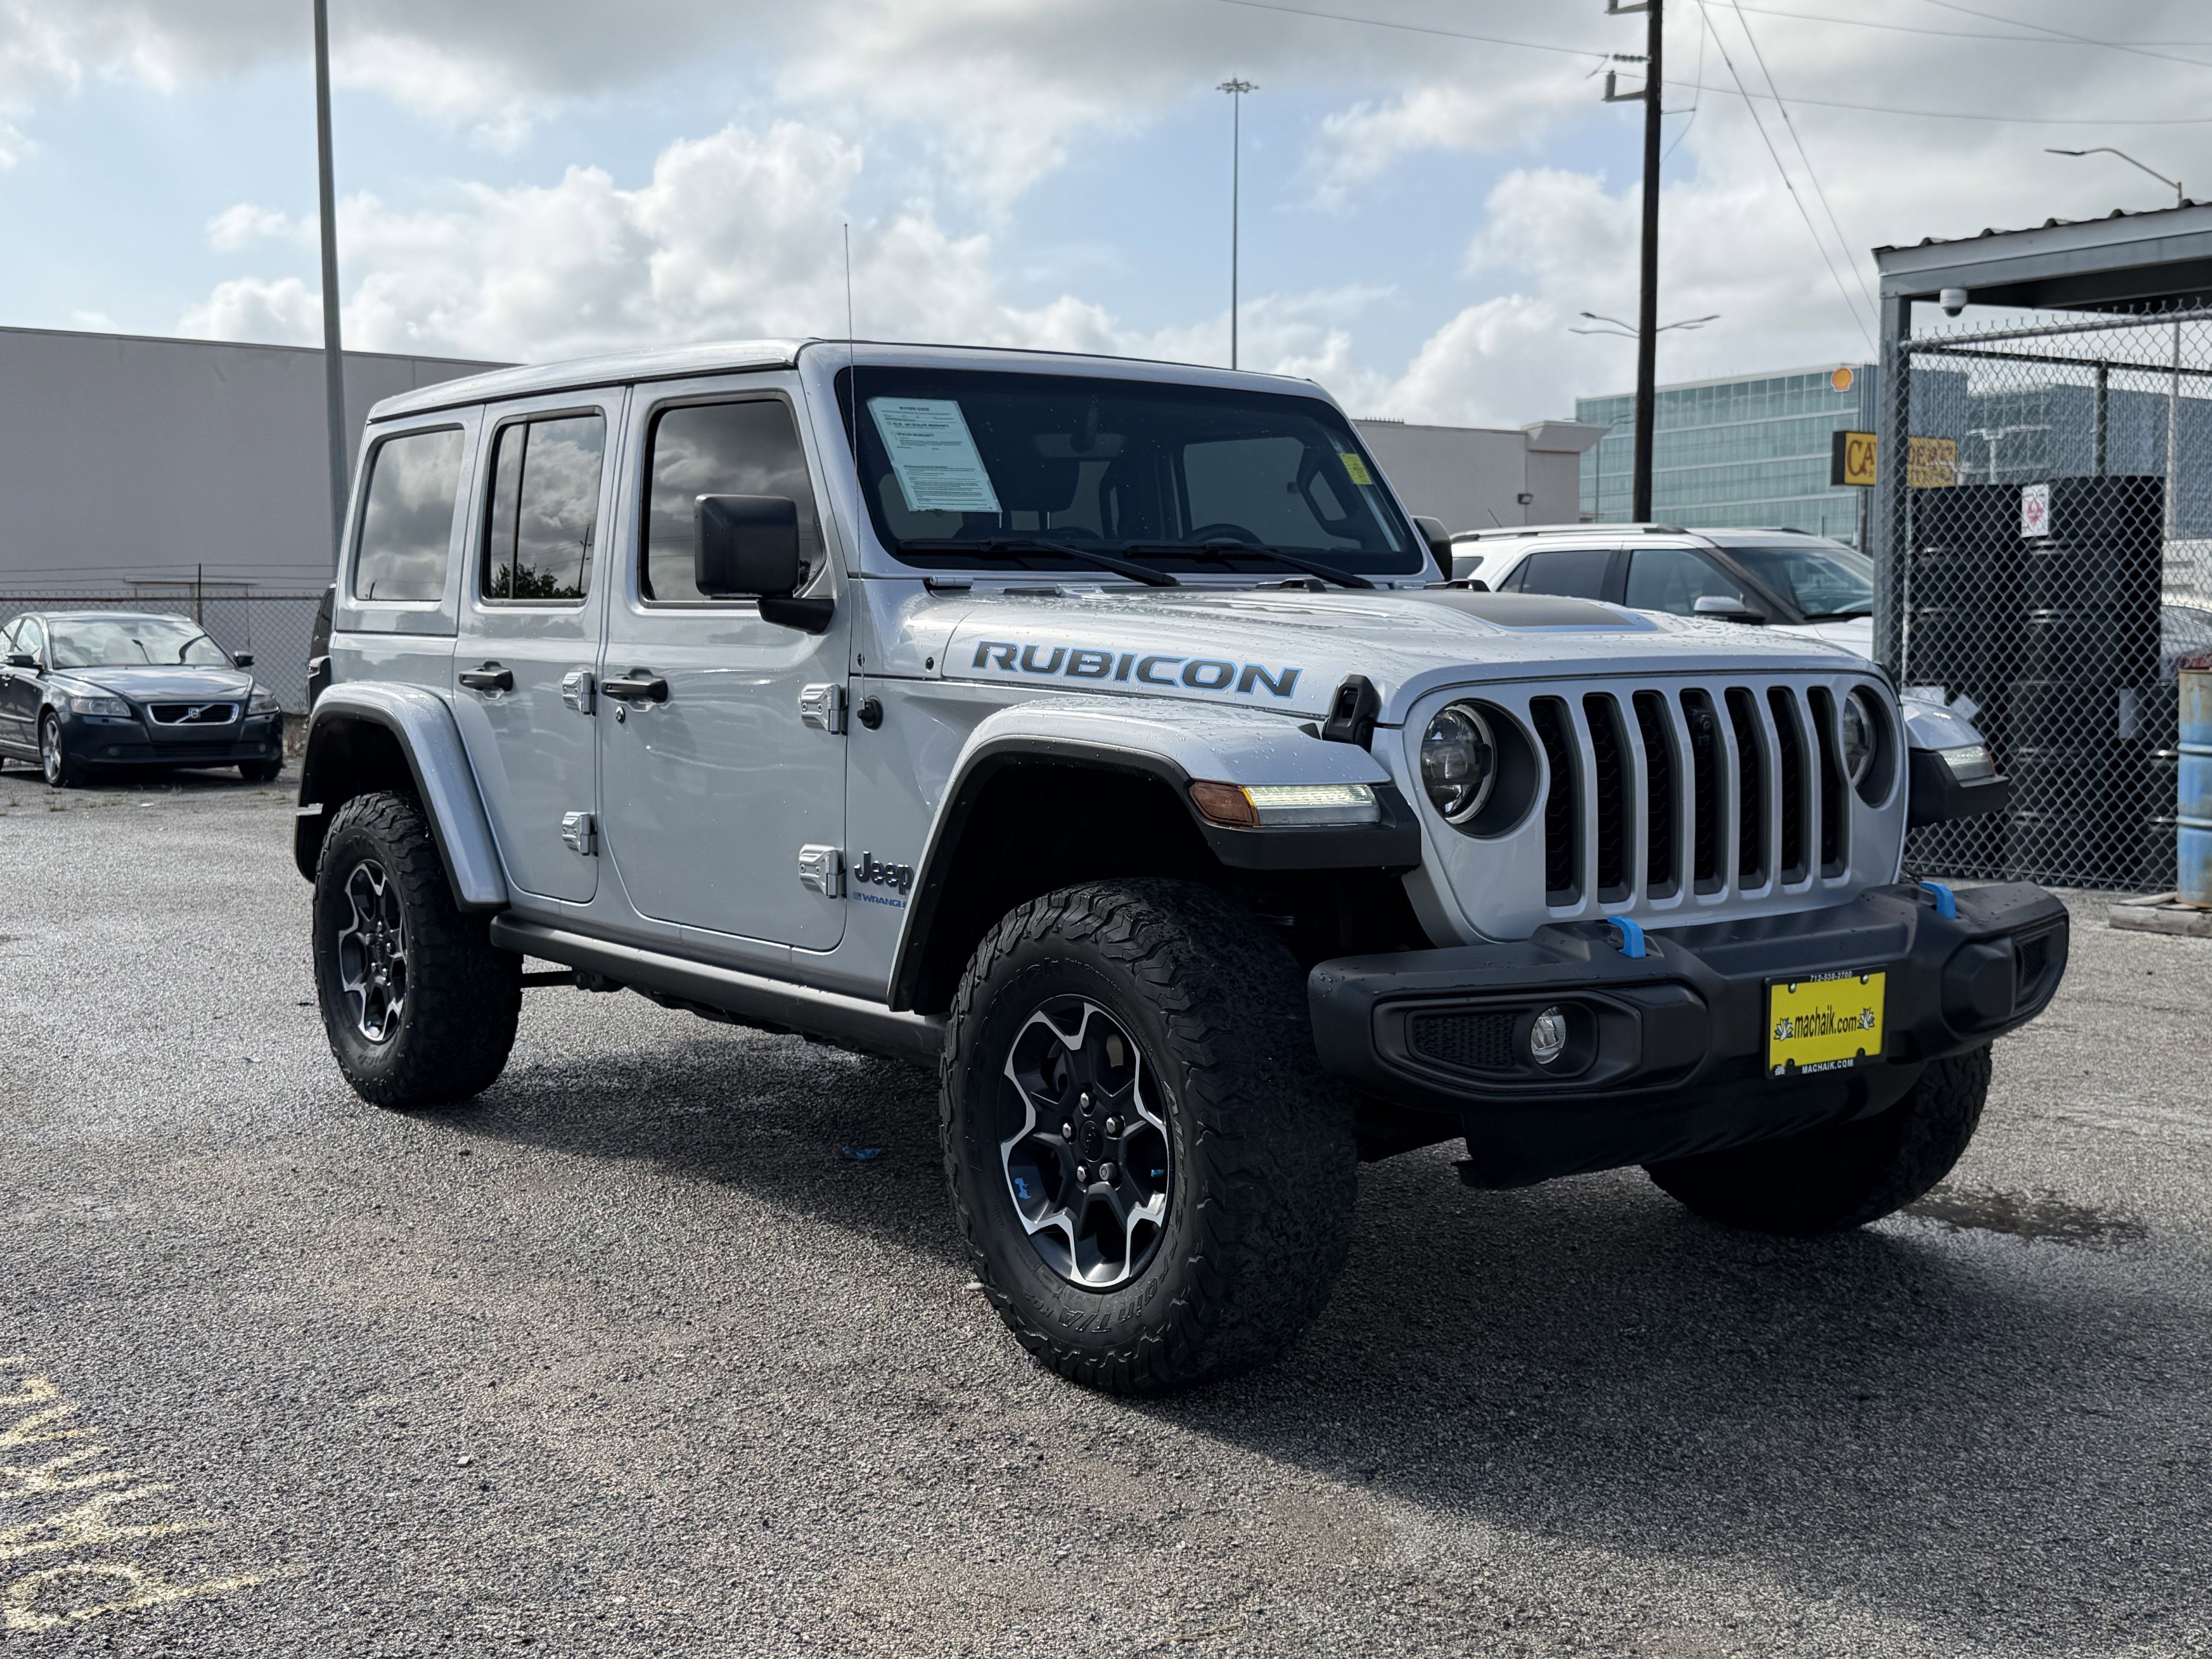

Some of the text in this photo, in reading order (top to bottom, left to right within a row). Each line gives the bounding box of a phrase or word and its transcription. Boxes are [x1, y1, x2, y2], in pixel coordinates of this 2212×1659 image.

[971, 640, 1304, 699] RUBICON
[854, 851, 915, 896] Jeep
[861, 893, 907, 908] WRANGL
[1794, 1004, 1856, 1039] machaik.com
[1802, 1058, 1853, 1074] MACHAIK.COM
